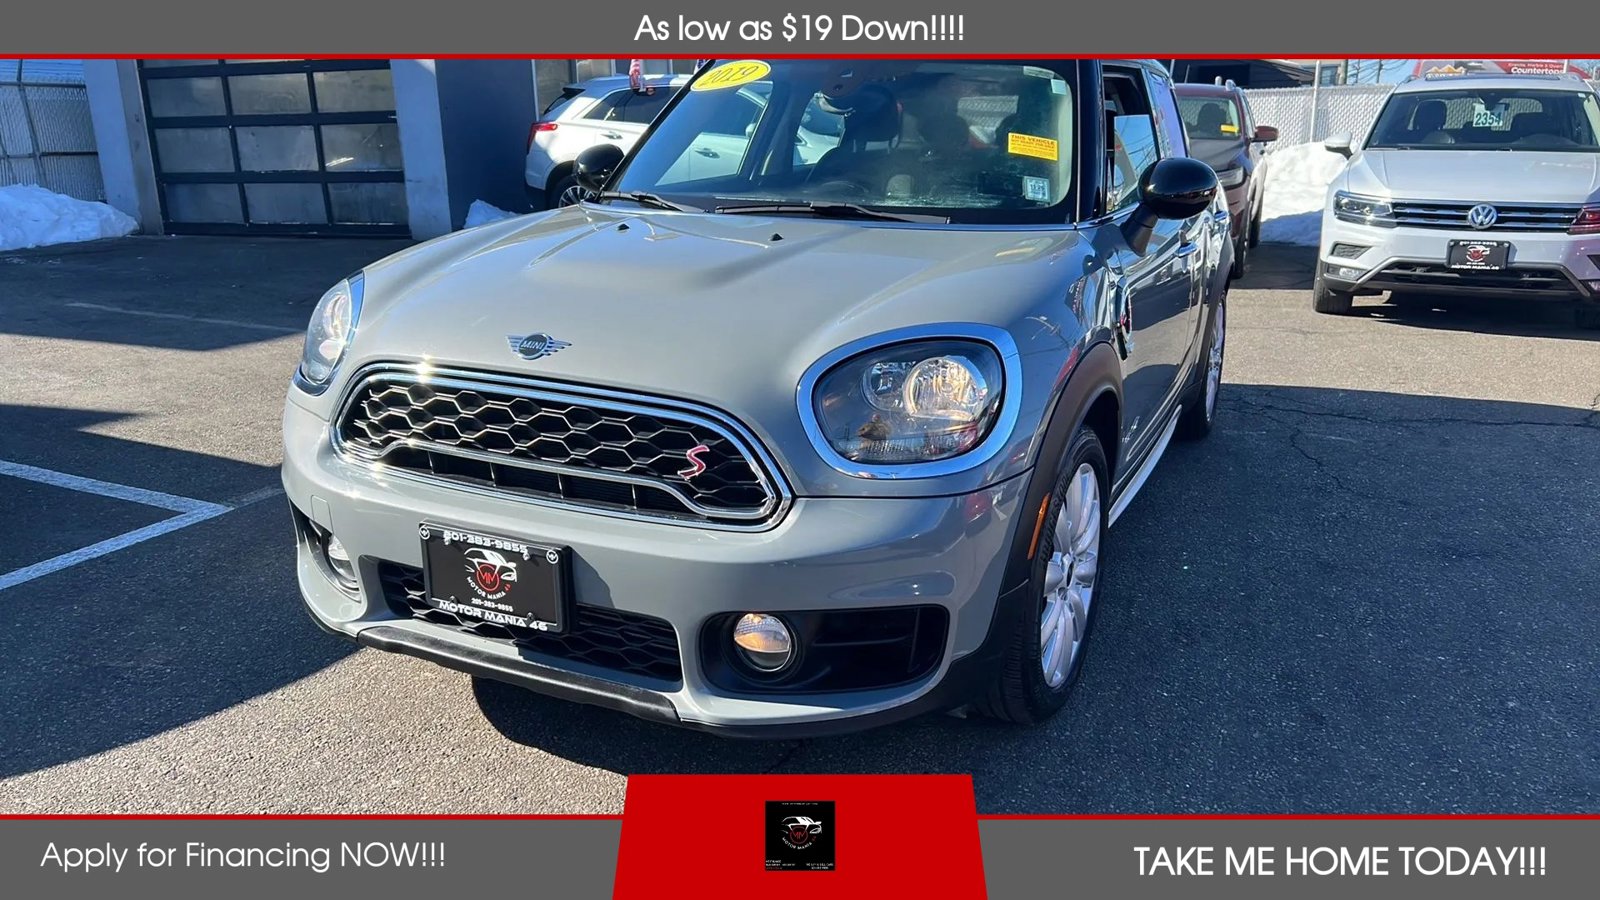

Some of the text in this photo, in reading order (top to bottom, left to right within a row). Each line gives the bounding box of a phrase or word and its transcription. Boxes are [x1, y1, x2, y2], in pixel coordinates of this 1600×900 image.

[698, 65, 759, 87] 2019
[521, 340, 546, 350] MINI
[439, 599, 548, 632] MOTOR MANIA 46
